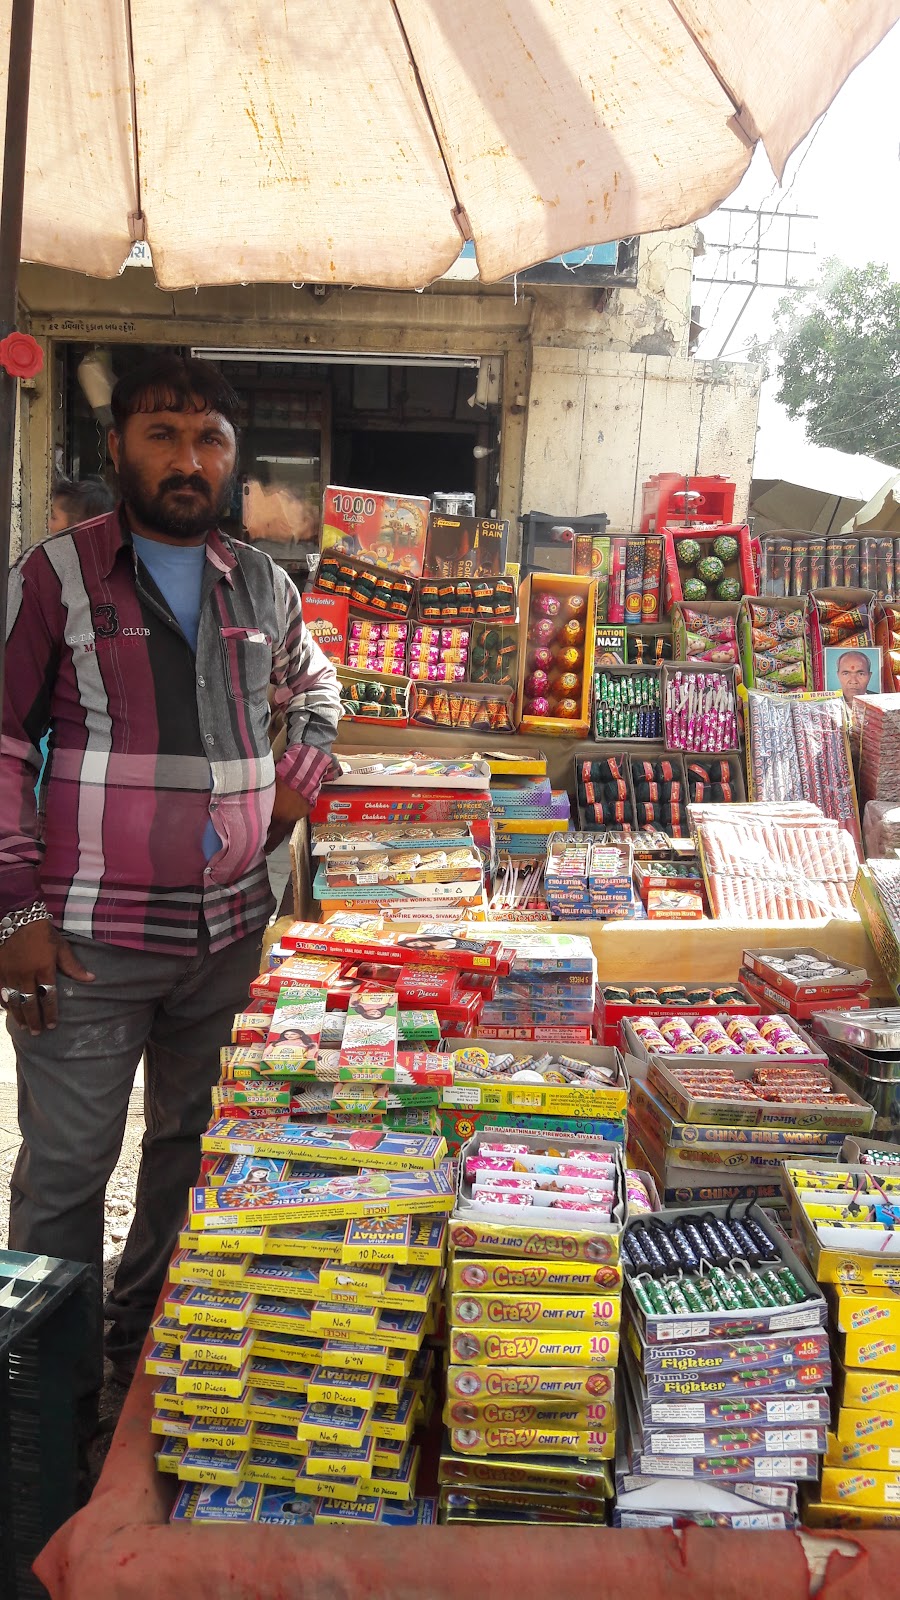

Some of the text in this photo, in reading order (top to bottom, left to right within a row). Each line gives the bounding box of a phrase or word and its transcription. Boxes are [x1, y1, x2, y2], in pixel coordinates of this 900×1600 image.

[333, 494, 377, 519] 1000
[343, 514, 366, 525] LAR
[482, 520, 504, 532] Gold
[482, 530, 503, 539] RAIN
[95, 604, 119, 638] 3
[122, 627, 151, 636] CLUB
[311, 627, 339, 638] SUMO
[318, 635, 344, 646] BOMB
[597, 637, 621, 647] NAZI
[296, 941, 328, 952] SRIRAM
[406, 988, 439, 999] 10 Pieces
[248, 1107, 291, 1118] SRIRAM
[762, 1115, 797, 1126] Mirchi
[800, 1115, 819, 1124] DX
[542, 1130, 576, 1139] FIREWORKS,
[705, 1129, 829, 1145] CHINA FIRE WORKS
[271, 1136, 314, 1145] ELECTRIC
[678, 1149, 746, 1166] CHINA DX
[408, 1162, 424, 1171] Pieces
[699, 1188, 741, 1201] CHINA
[272, 1197, 320, 1206] ELECTRIC
[366, 1206, 389, 1214] NCLE
[352, 1232, 404, 1240] BHARAT
[220, 1240, 240, 1250] No.9
[480, 1234, 578, 1259] Crazy CHIT PUT
[358, 1249, 395, 1261] 10 Pieces
[192, 1267, 226, 1278] 10 Pieces
[493, 1266, 592, 1288] Crazy CHIT PUT
[191, 1292, 245, 1305] BHARAT
[334, 1294, 356, 1302] NCLE
[488, 1300, 613, 1324] Crazy CHIT PUT 10
[193, 1312, 228, 1324] 10 Pieces
[332, 1318, 352, 1328] No.9
[191, 1327, 244, 1341] BHARAT
[326, 1330, 348, 1338] NCLE
[485, 1335, 610, 1360] Crazy CHIT PUT 10
[801, 1342, 815, 1353] 10
[193, 1348, 228, 1361] 10 Pieces
[651, 1348, 697, 1363] Jumbo
[798, 1350, 821, 1359] PIECES
[344, 1356, 365, 1366] No.9
[661, 1357, 724, 1371] Fighter
[803, 1367, 817, 1377] 10
[318, 1373, 369, 1383] BHARAT
[654, 1374, 699, 1387] Jumbo
[801, 1375, 823, 1384] PIECES
[192, 1381, 228, 1393] 10 Pieces
[486, 1373, 584, 1395] Crazy CHIT PUT
[664, 1381, 727, 1396] Fighter
[320, 1390, 357, 1403] 10 Pieces
[196, 1404, 230, 1416] 10 Pieces
[483, 1404, 606, 1424] Crazy CHIT PUT 10
[196, 1416, 247, 1428] BHARAT
[201, 1436, 236, 1447] 10 Pieces
[319, 1432, 339, 1442] No.9
[485, 1428, 608, 1449] Crazy CHIT PUT 10
[327, 1464, 347, 1474] No.9
[199, 1470, 218, 1480] No.9
[316, 1485, 336, 1495] No.9
[372, 1487, 399, 1497] 10 Pieces
[325, 1499, 377, 1512] BHARAT
